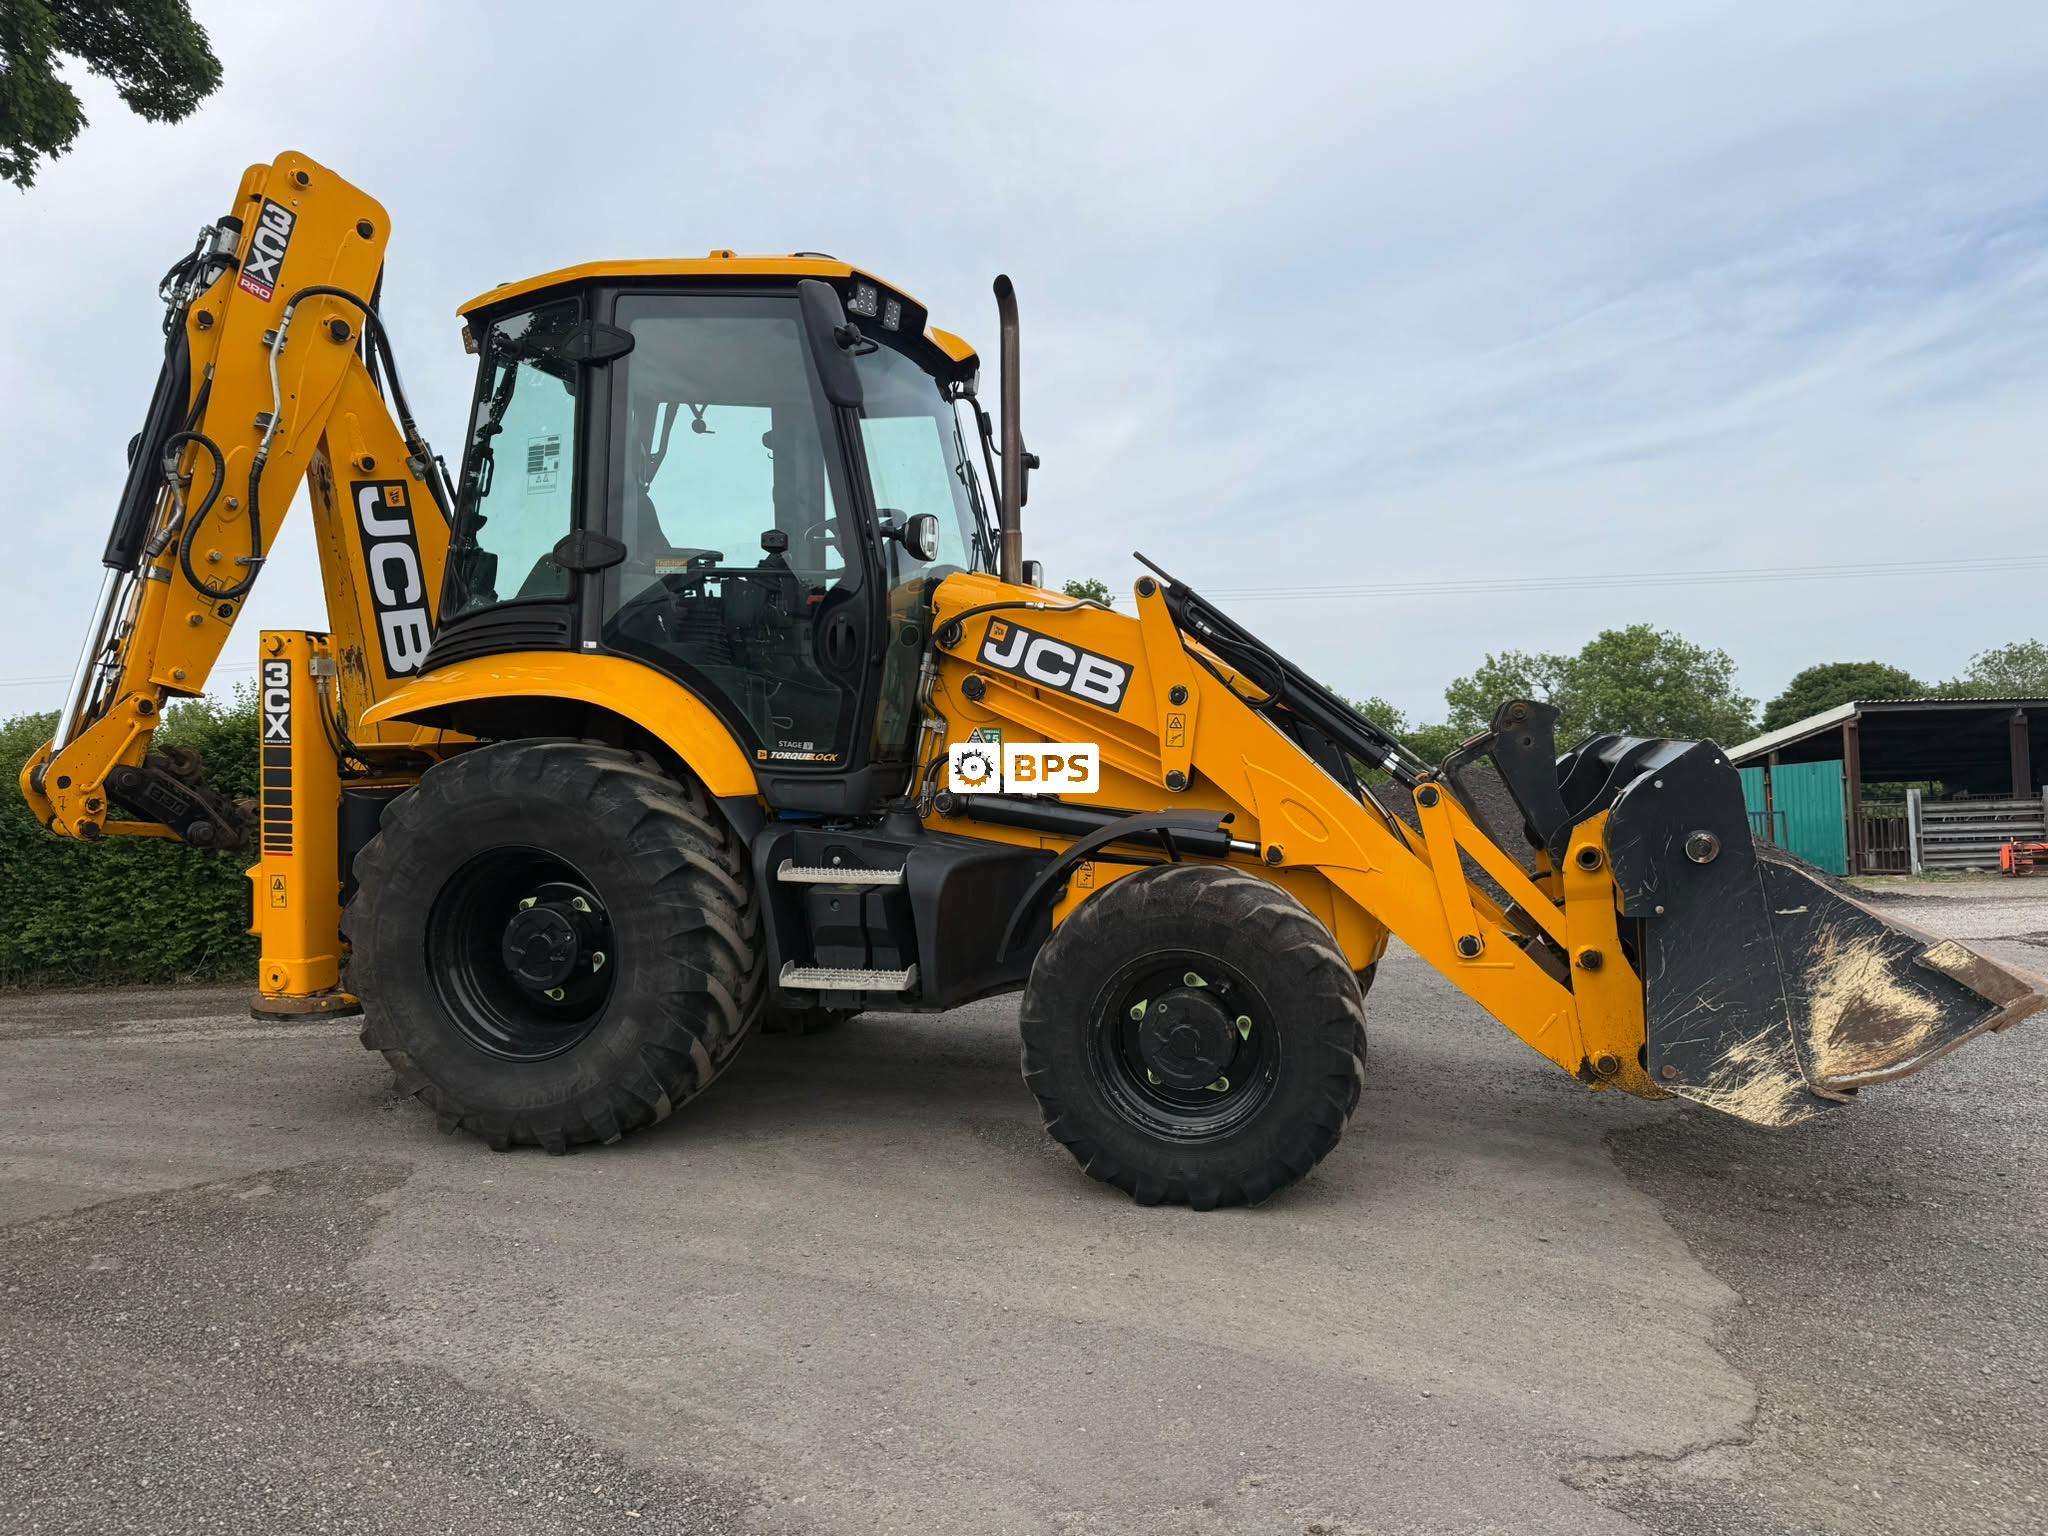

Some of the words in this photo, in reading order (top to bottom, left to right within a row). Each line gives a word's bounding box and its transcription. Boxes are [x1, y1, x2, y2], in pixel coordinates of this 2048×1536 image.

[245, 203, 293, 284] 3CX
[240, 278, 271, 299] PRO
[358, 486, 432, 673] JCB
[264, 662, 291, 738] 3CX
[983, 629, 1126, 705] JCB
[770, 751, 838, 762] TORQUELOCK
[778, 740, 803, 749] STAGE
